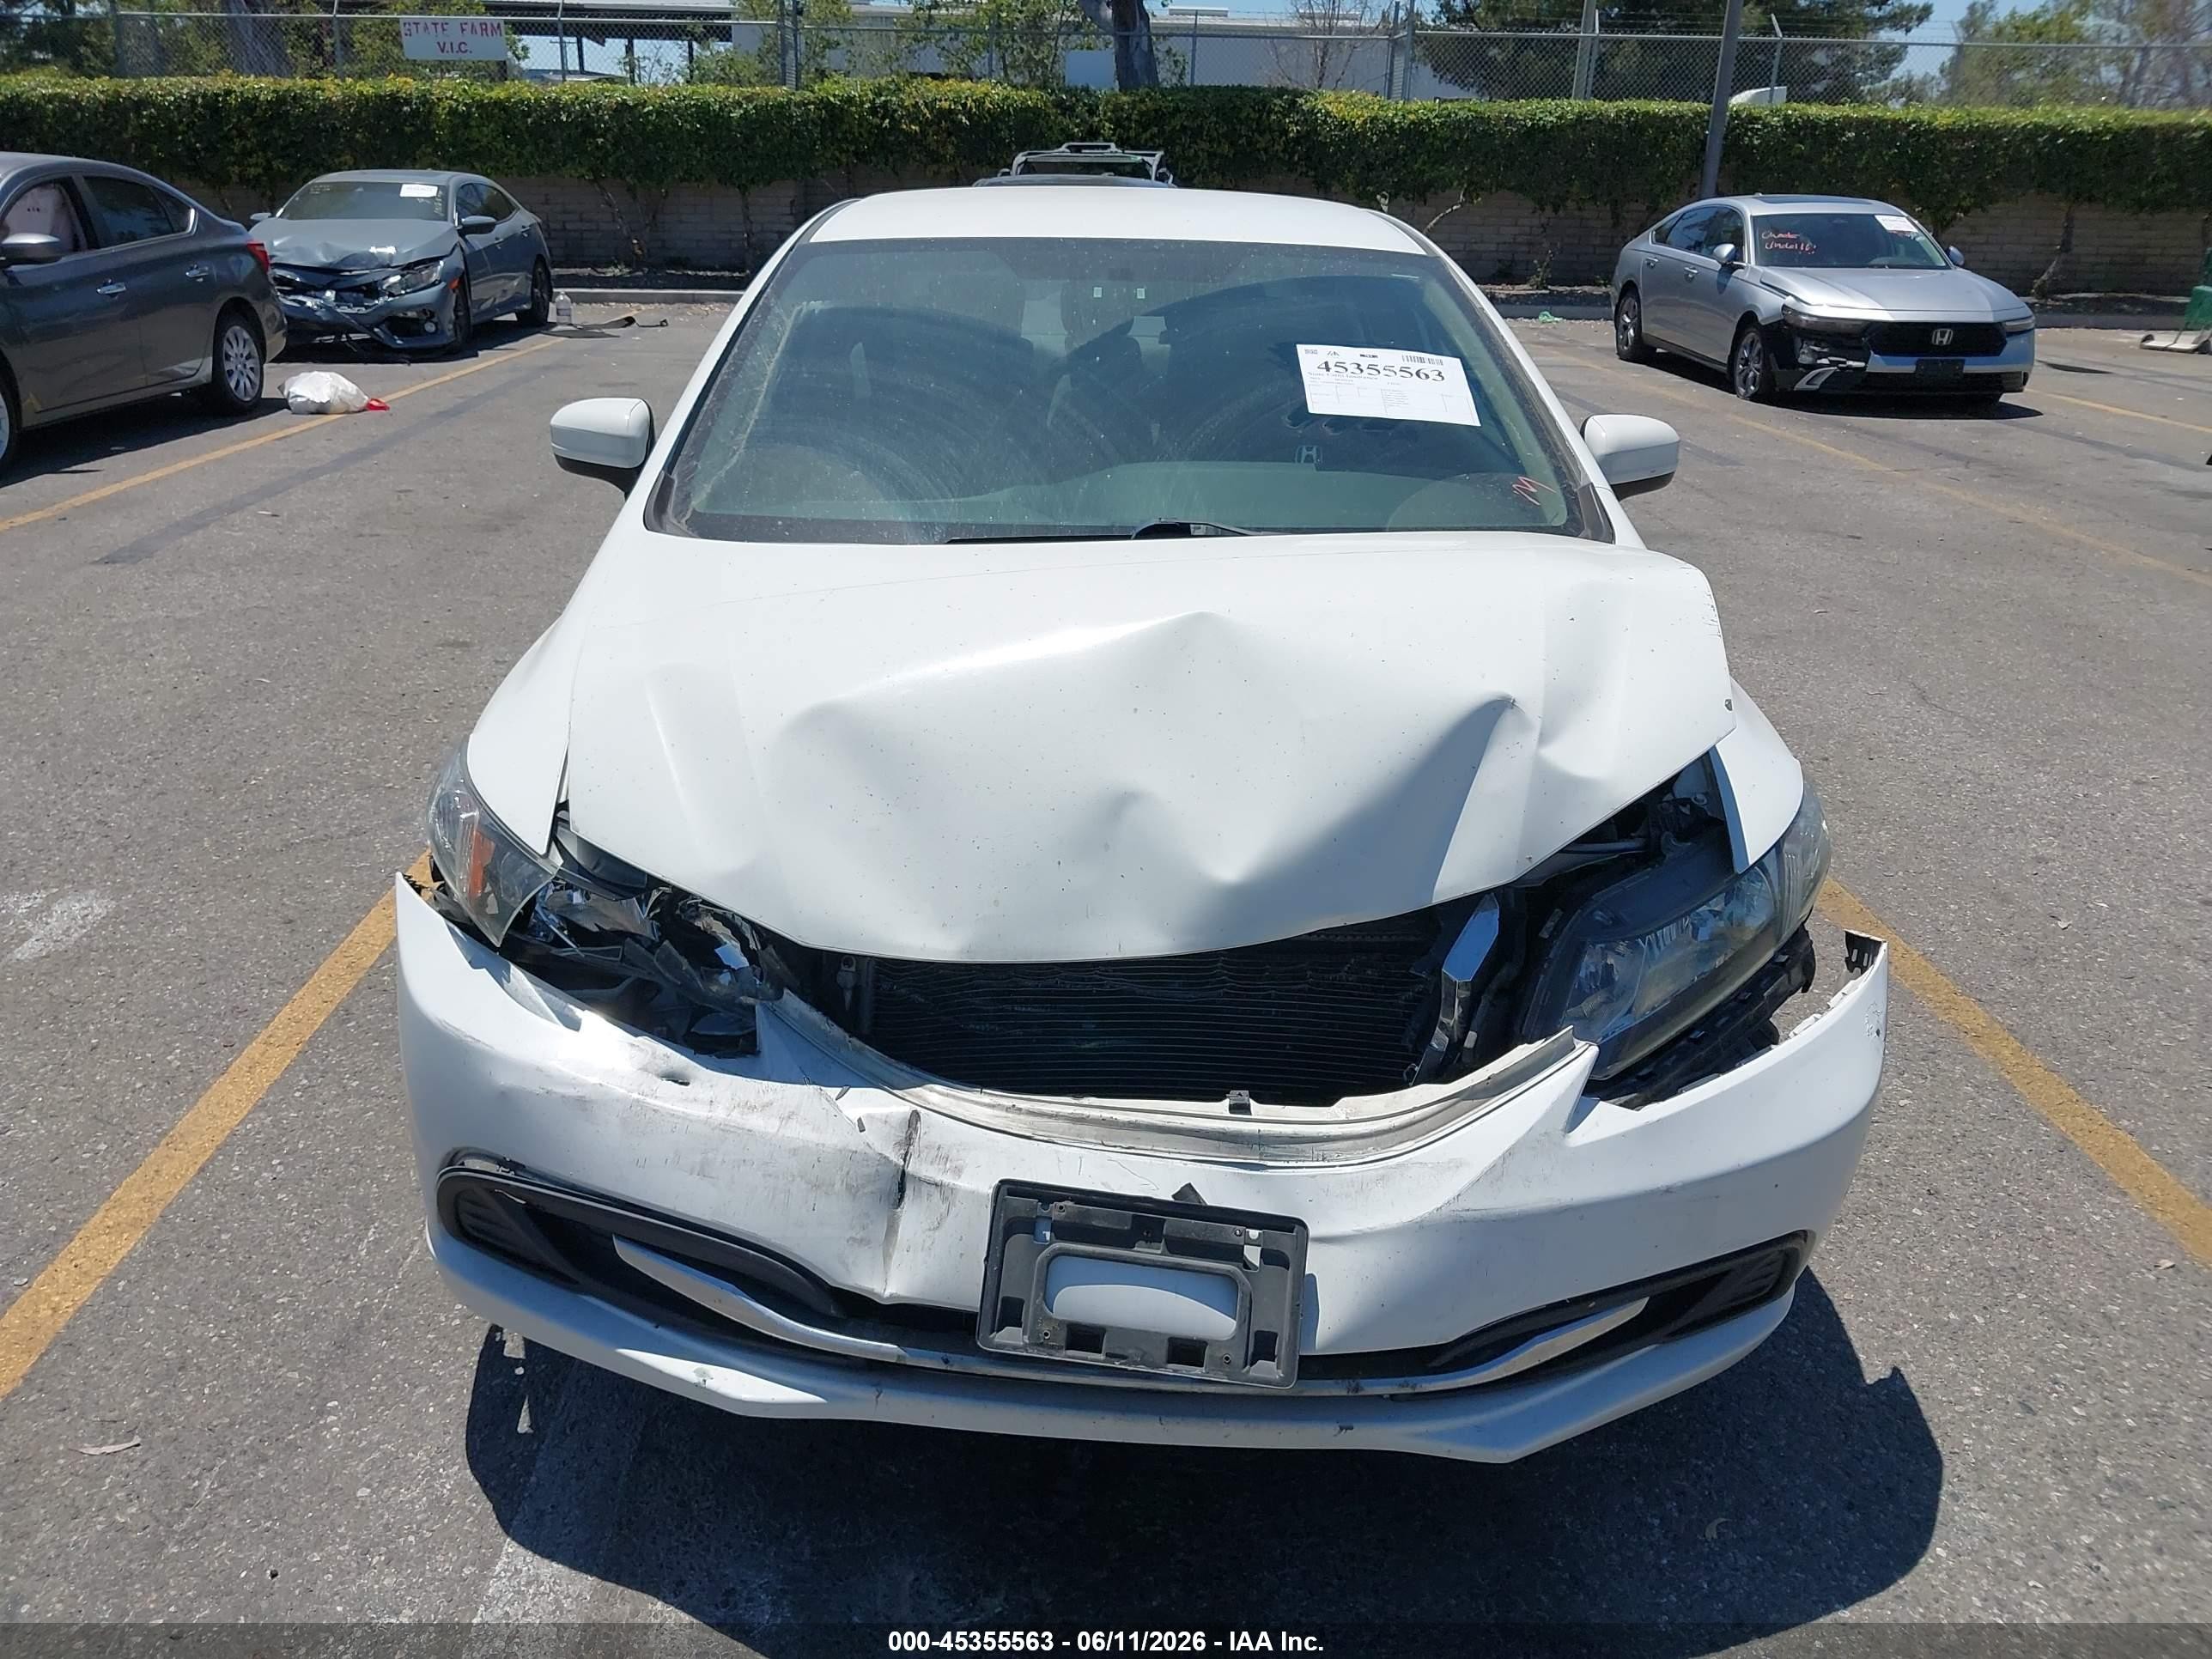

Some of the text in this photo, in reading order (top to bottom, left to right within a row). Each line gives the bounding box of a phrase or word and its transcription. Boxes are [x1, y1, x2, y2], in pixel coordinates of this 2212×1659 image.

[403, 21, 503, 38] STATE FARM
[436, 41, 473, 54] V.I.C.
[1316, 360, 1445, 382] 45355563
